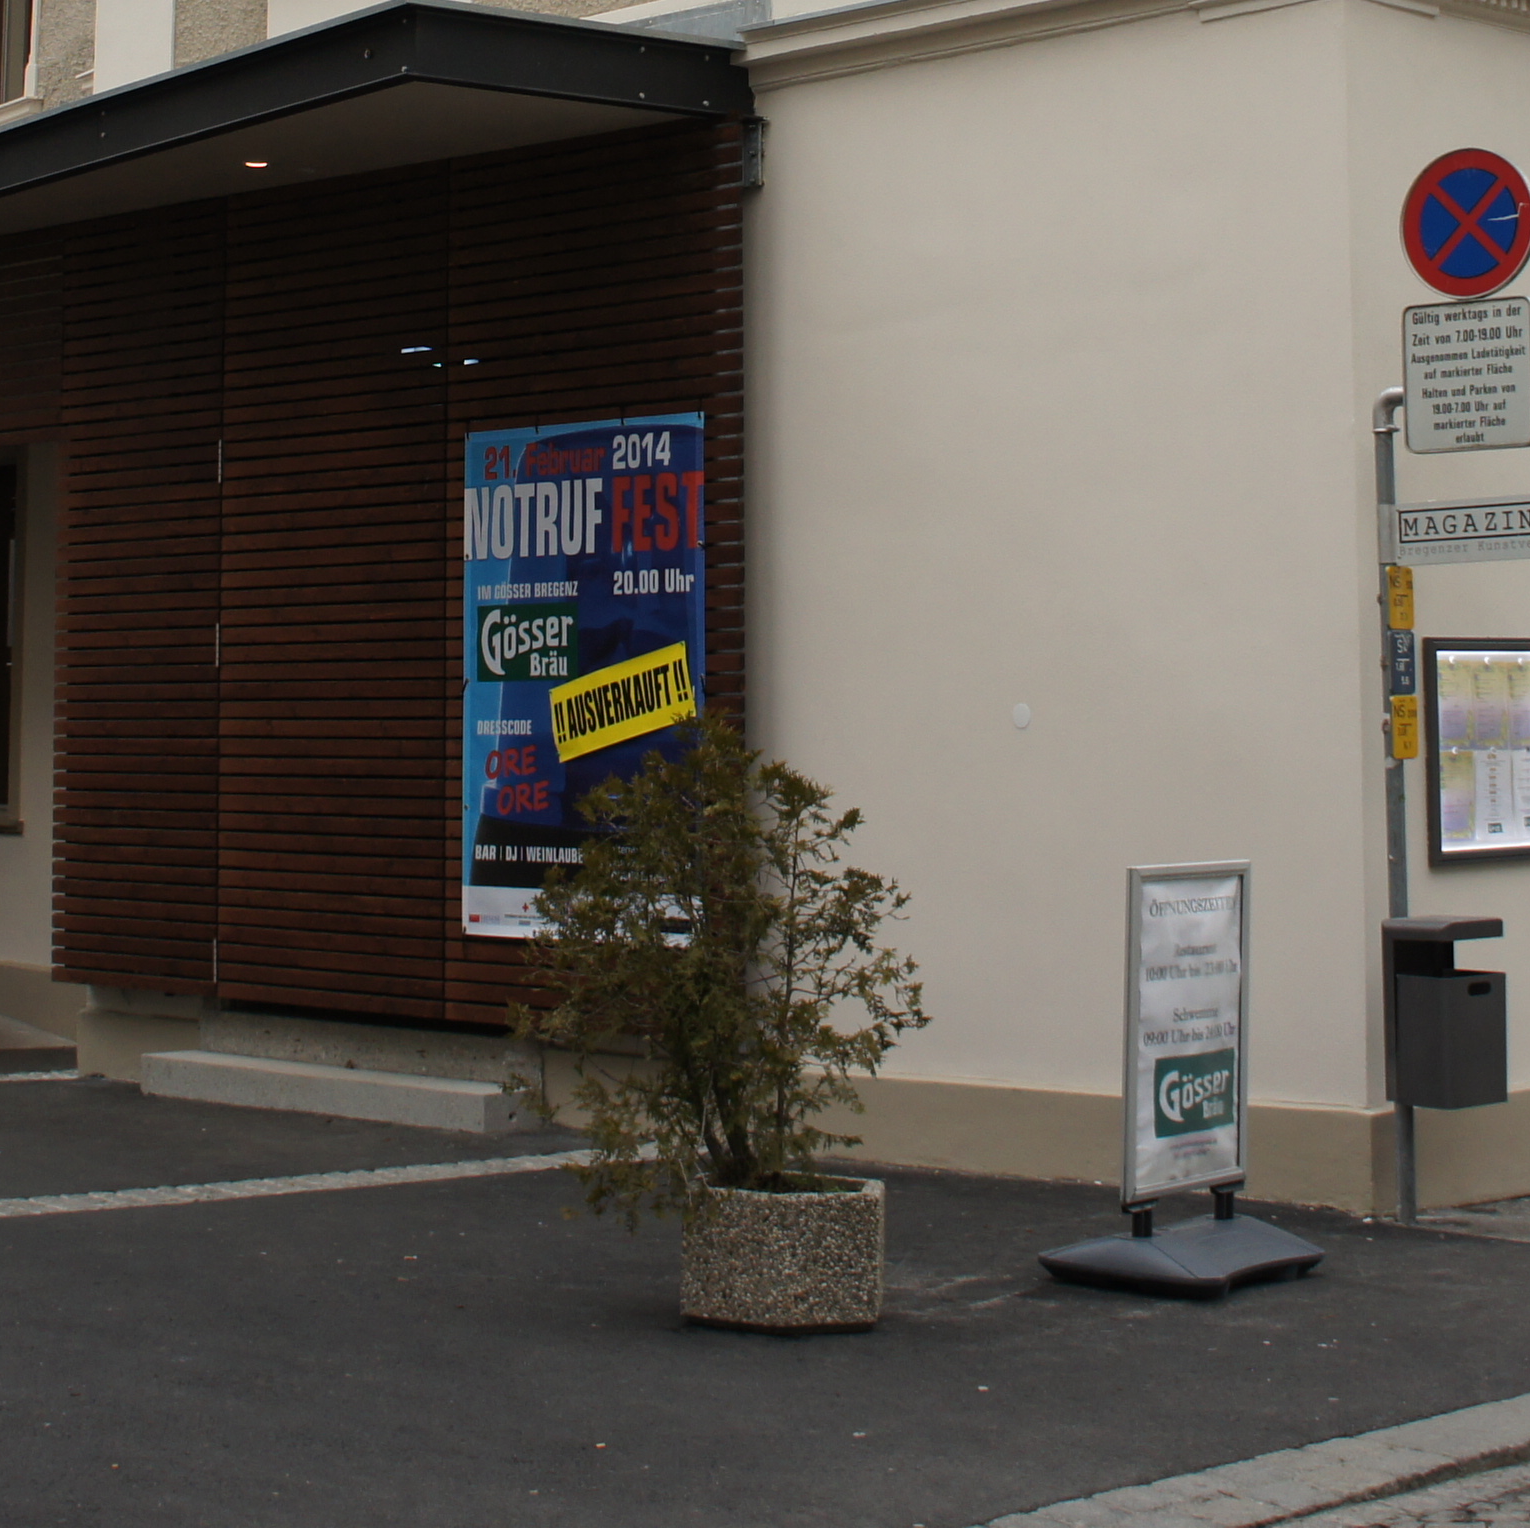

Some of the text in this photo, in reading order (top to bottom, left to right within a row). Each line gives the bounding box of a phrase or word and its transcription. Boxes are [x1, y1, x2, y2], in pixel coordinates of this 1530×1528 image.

[1412, 305, 1522, 326] Gültig werktags in der
[1412, 326, 1523, 347] Zeit von 7.00-19.00 Uhr
[1411, 345, 1526, 365] Ausgenommen Ladetätigkeit
[1424, 362, 1513, 380] auf markierter Fläche
[1422, 383, 1516, 399] Halten und Parken von
[1432, 399, 1506, 415] 19.00-7.00 Uhr auf
[1433, 416, 1506, 430] markierter Fläche
[1455, 432, 1485, 443] erlaubt
[484, 430, 671, 481] 21. Februar 2014
[464, 470, 705, 561] NOTRUF FEST
[1399, 542, 1469, 557] Bregenzer
[477, 580, 578, 600] IM GÖSSER BREGENZ
[613, 568, 695, 595] 20.00 Uhr
[481, 608, 574, 676] Gösser
[530, 651, 568, 677] Bräu
[569, 666, 672, 738] AUSVERKAUFT
[476, 719, 532, 736] DRESSCODE
[485, 744, 538, 780] ORE
[497, 780, 550, 816] ORE
[475, 844, 497, 861] BAR
[505, 845, 518, 862] DJ
[1159, 1069, 1230, 1123] Gösser
